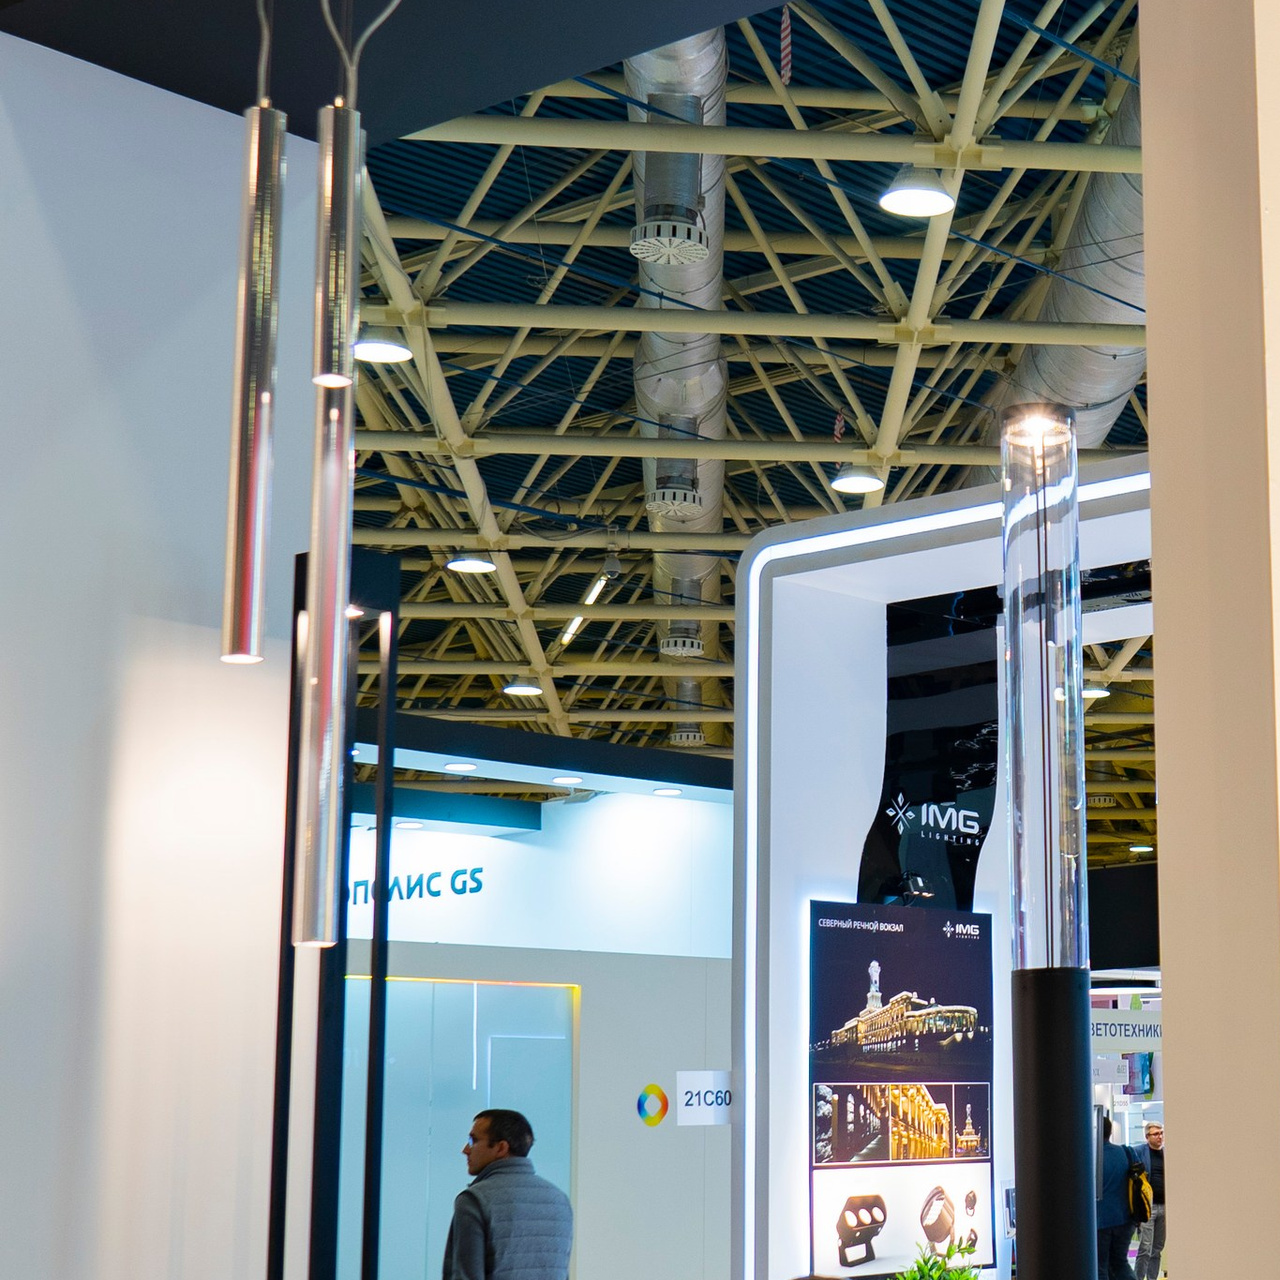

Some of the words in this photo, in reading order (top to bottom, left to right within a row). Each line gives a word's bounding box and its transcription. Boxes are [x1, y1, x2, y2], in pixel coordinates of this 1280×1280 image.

[921, 803, 980, 835] IMG
[921, 830, 980, 846] LIGHTING
[347, 871, 441, 905] ПЛИС
[450, 867, 483, 895] GS
[818, 918, 853, 929] СЕВЕРНЫЙ
[853, 920, 879, 931] РЕЧНОЙ
[879, 922, 904, 933] ВОКЗАЛ
[955, 923, 980, 935] IMG
[1091, 1022, 1162, 1038] ВЕТОТЕХНИК
[684, 1090, 732, 1107] 21C60
